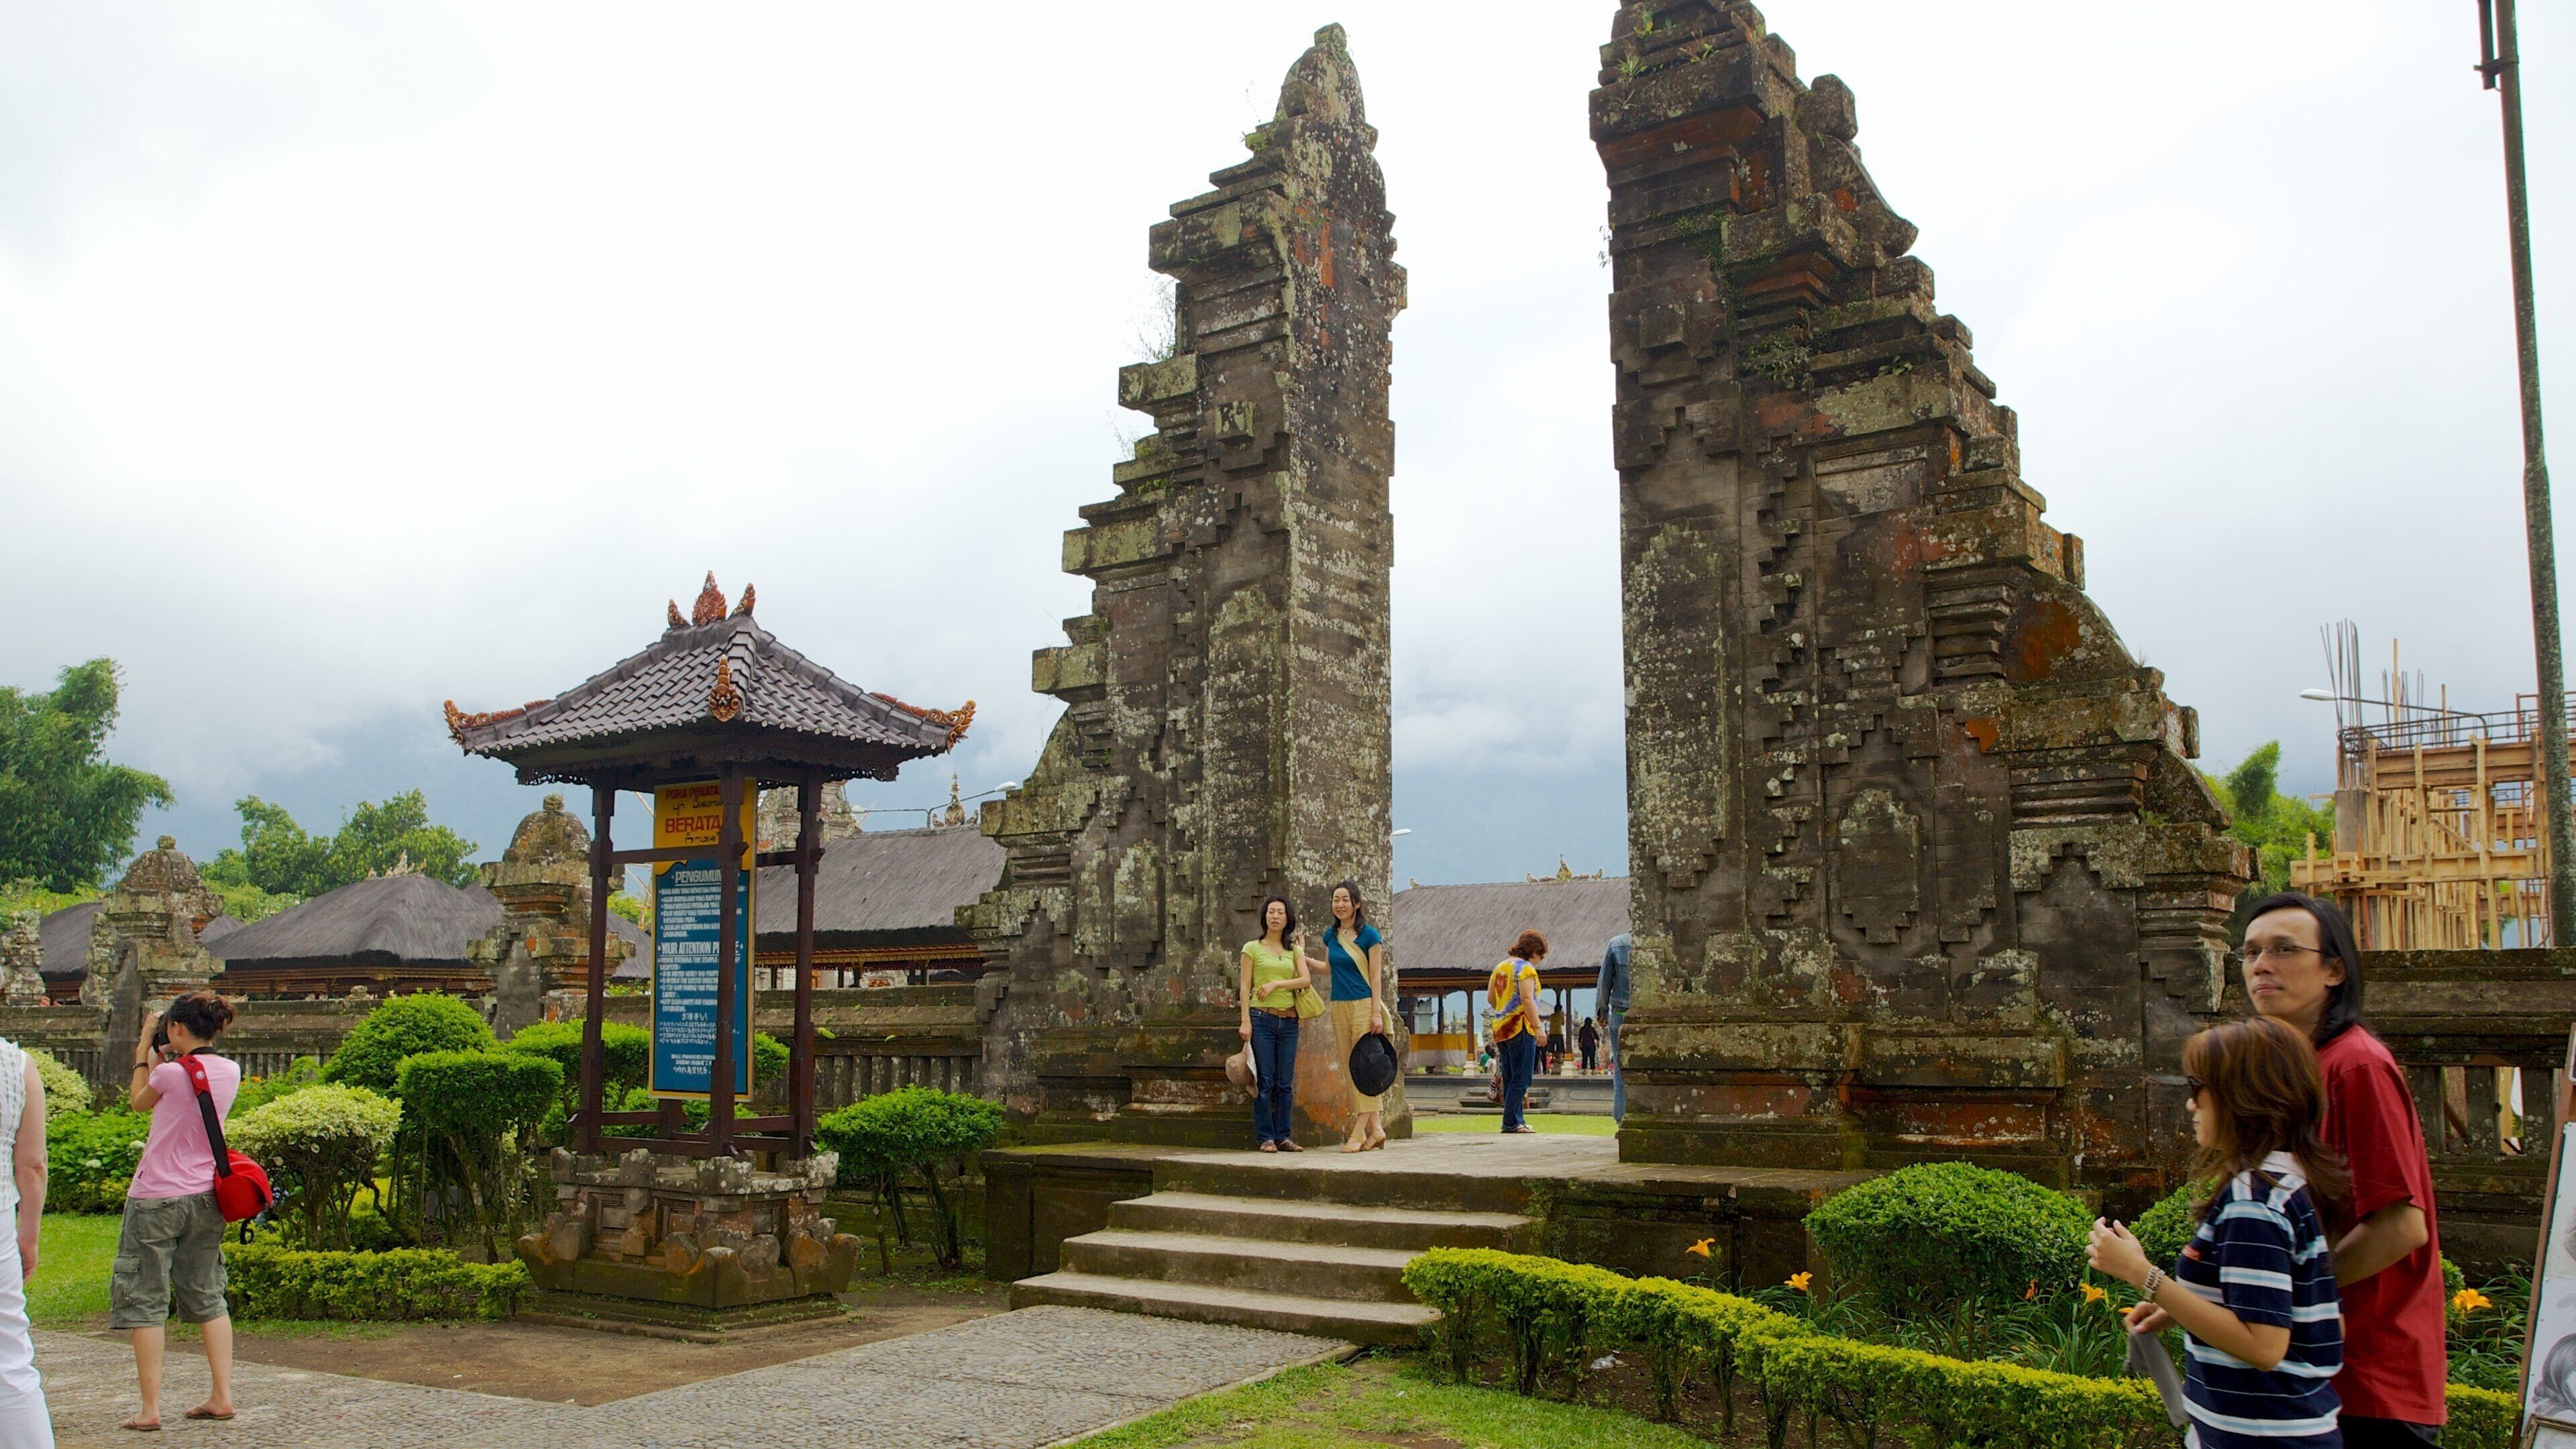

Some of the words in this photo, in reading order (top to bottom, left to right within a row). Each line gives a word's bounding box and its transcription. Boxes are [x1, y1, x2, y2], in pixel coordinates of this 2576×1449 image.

[665, 788, 688, 799] PURA
[690, 786, 720, 798] PENATA
[665, 814, 721, 833] BERATA
[661, 943, 678, 954] YOUR
[678, 941, 712, 954] ATTENTION
